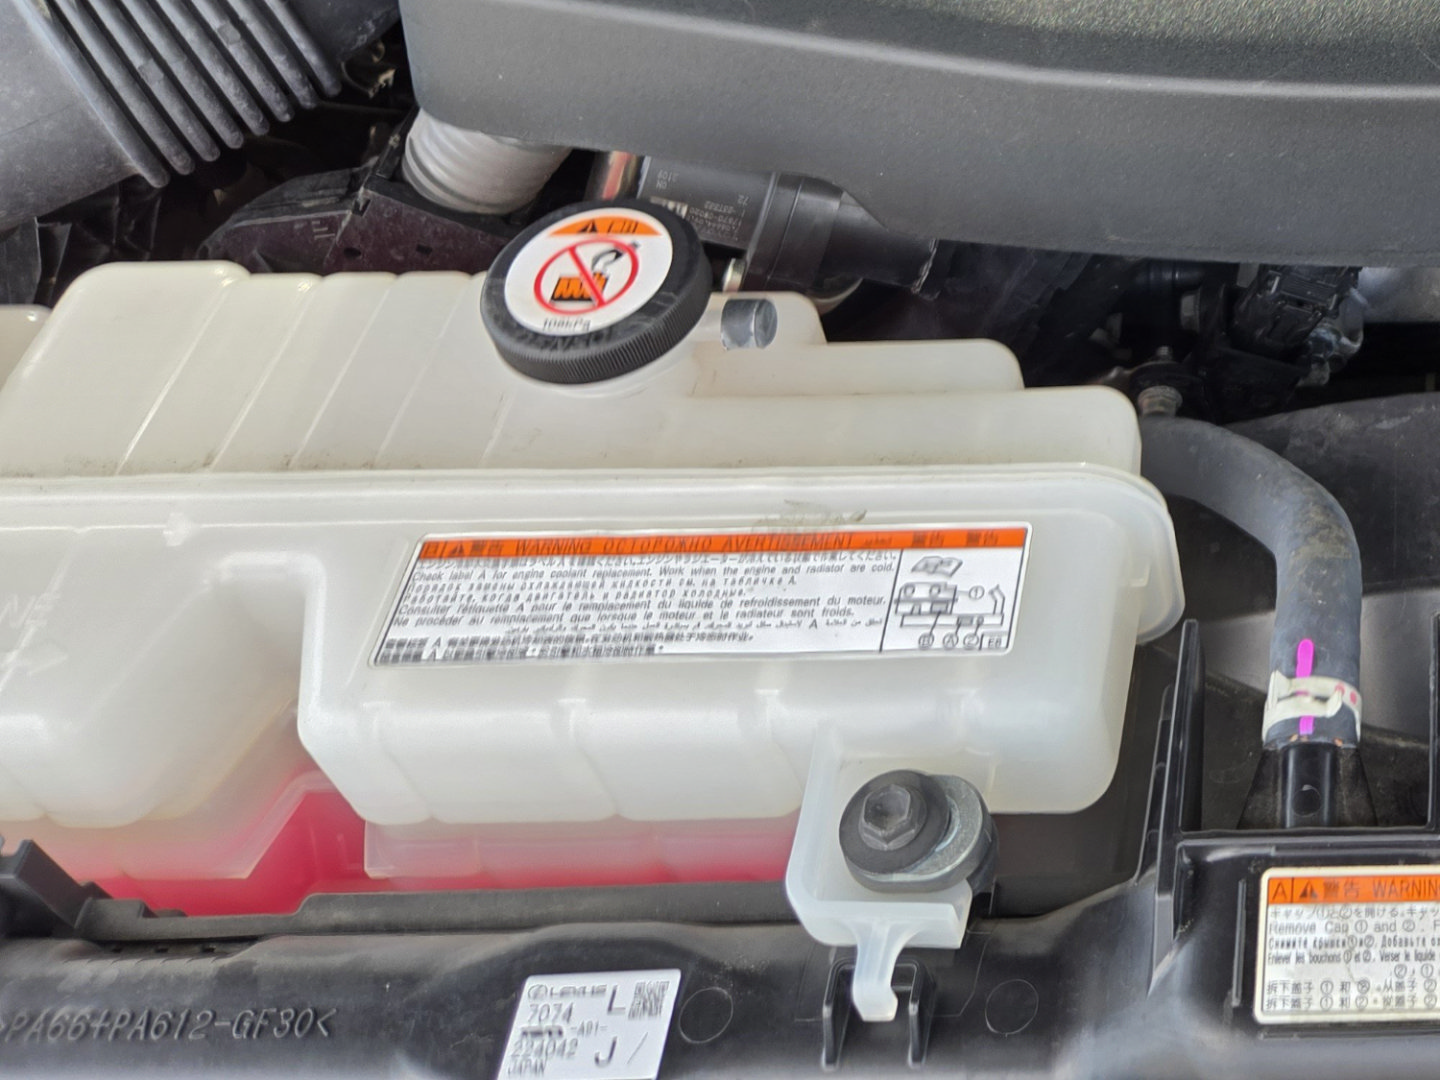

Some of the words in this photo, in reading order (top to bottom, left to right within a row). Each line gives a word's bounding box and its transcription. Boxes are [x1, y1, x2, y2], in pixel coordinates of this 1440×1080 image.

[515, 537, 593, 556] WARNING
[720, 531, 853, 552] AVERTISSEMENT
[411, 571, 444, 582] Check
[449, 570, 474, 581] label
[477, 570, 488, 580] A
[491, 570, 508, 580] for
[512, 569, 545, 581] engine
[551, 568, 588, 578] coolant
[593, 567, 652, 581] replacement.
[659, 566, 685, 576] Work
[690, 566, 717, 576] when
[723, 566, 739, 575] the
[744, 565, 776, 578] engine
[781, 564, 801, 574] and
[806, 563, 845, 574] radiator
[850, 563, 867, 572] are
[871, 562, 895, 572] cold.
[702, 577, 717, 587] на
[398, 604, 452, 615] Consulter
[529, 603, 557, 613] pour
[562, 601, 573, 611] le
[578, 600, 651, 613] remplacement
[656, 599, 672, 609] du
[678, 599, 715, 611] liquide
[720, 598, 734, 609] de
[739, 596, 821, 608] refroidissement
[826, 596, 842, 606] du
[846, 595, 887, 606] moteur.
[392, 617, 410, 627] Ne
[468, 616, 487, 626] au
[489, 613, 565, 626] remplacement
[569, 614, 592, 624] que
[597, 612, 638, 623] lorsque
[643, 610, 654, 620] le
[659, 610, 695, 621] moteur
[702, 610, 715, 620] et
[720, 609, 730, 621] le
[735, 608, 784, 619] radiateur
[789, 608, 815, 618] sont
[820, 606, 855, 618] froids.
[1272, 881, 1288, 901] A
[1268, 922, 1317, 934] Remove
[1324, 921, 1350, 934] Cap
[1373, 921, 1397, 933] and
[1267, 951, 1291, 964] Enlever
[1295, 952, 1306, 964] les
[1309, 952, 1341, 964] bouchons
[1380, 951, 1400, 962] Verser
[1413, 950, 1436, 963] liquide
[594, 1035, 618, 1068] J
